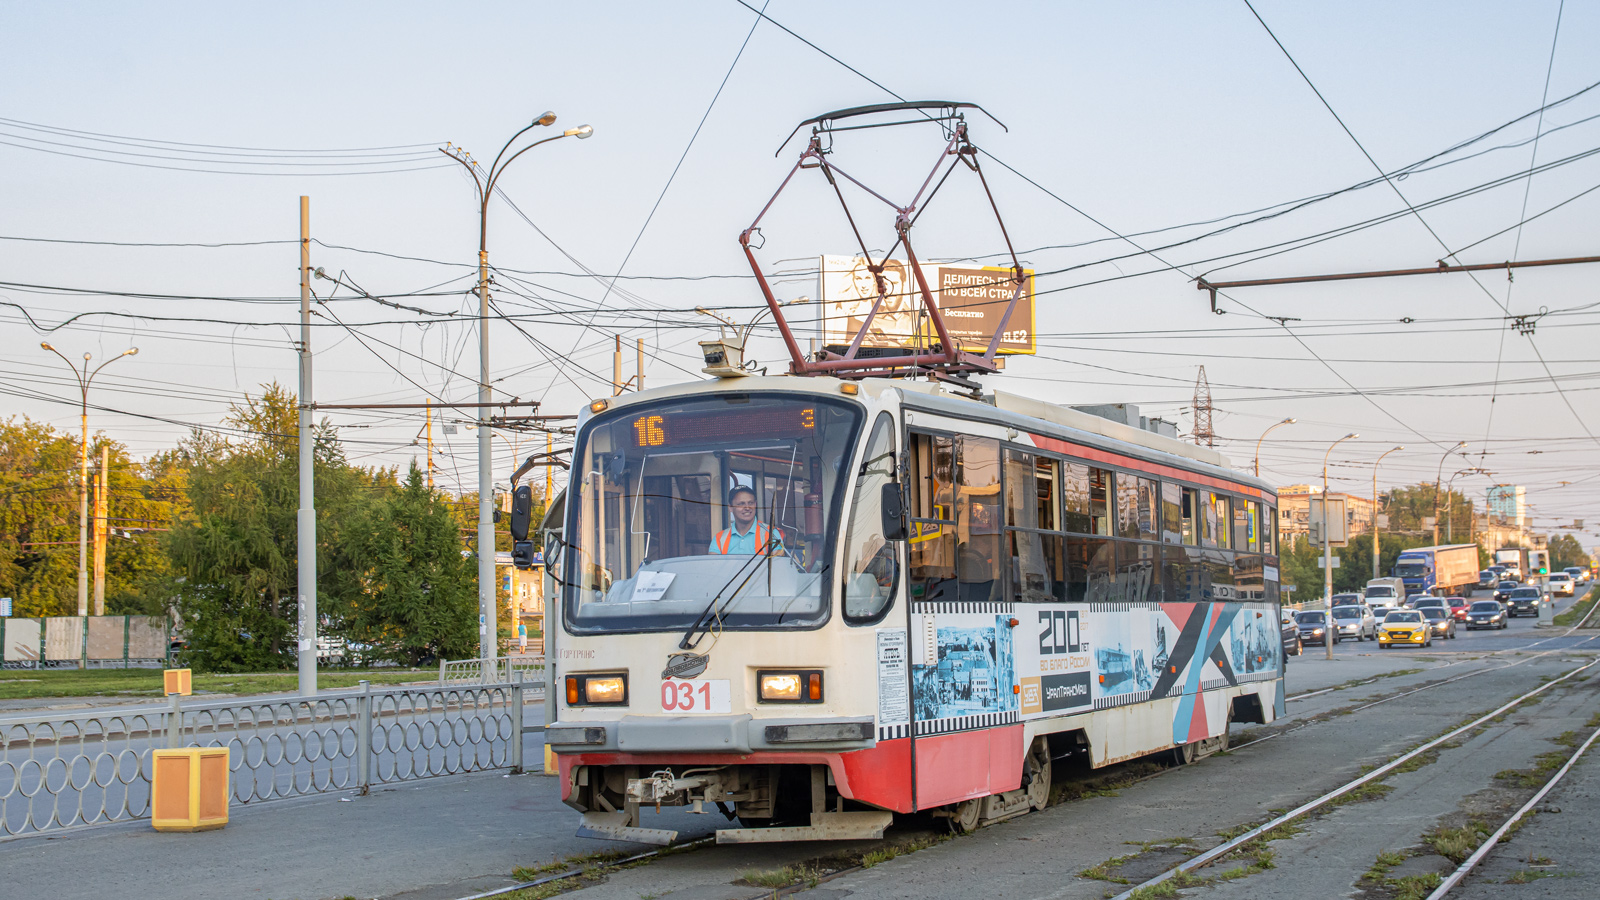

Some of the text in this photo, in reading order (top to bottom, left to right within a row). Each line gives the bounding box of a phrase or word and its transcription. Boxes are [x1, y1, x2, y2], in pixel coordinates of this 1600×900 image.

[943, 274, 995, 285] ДЕЛИТЕСЬ
[944, 286, 1026, 300] ПО ВСЕЙ СТРАЕ
[944, 308, 984, 318] Бесплатно
[1001, 330, 1027, 343] ELE2
[801, 409, 814, 428] 3
[634, 416, 664, 446] 16
[1038, 610, 1080, 655] 200
[661, 681, 711, 711] 031
